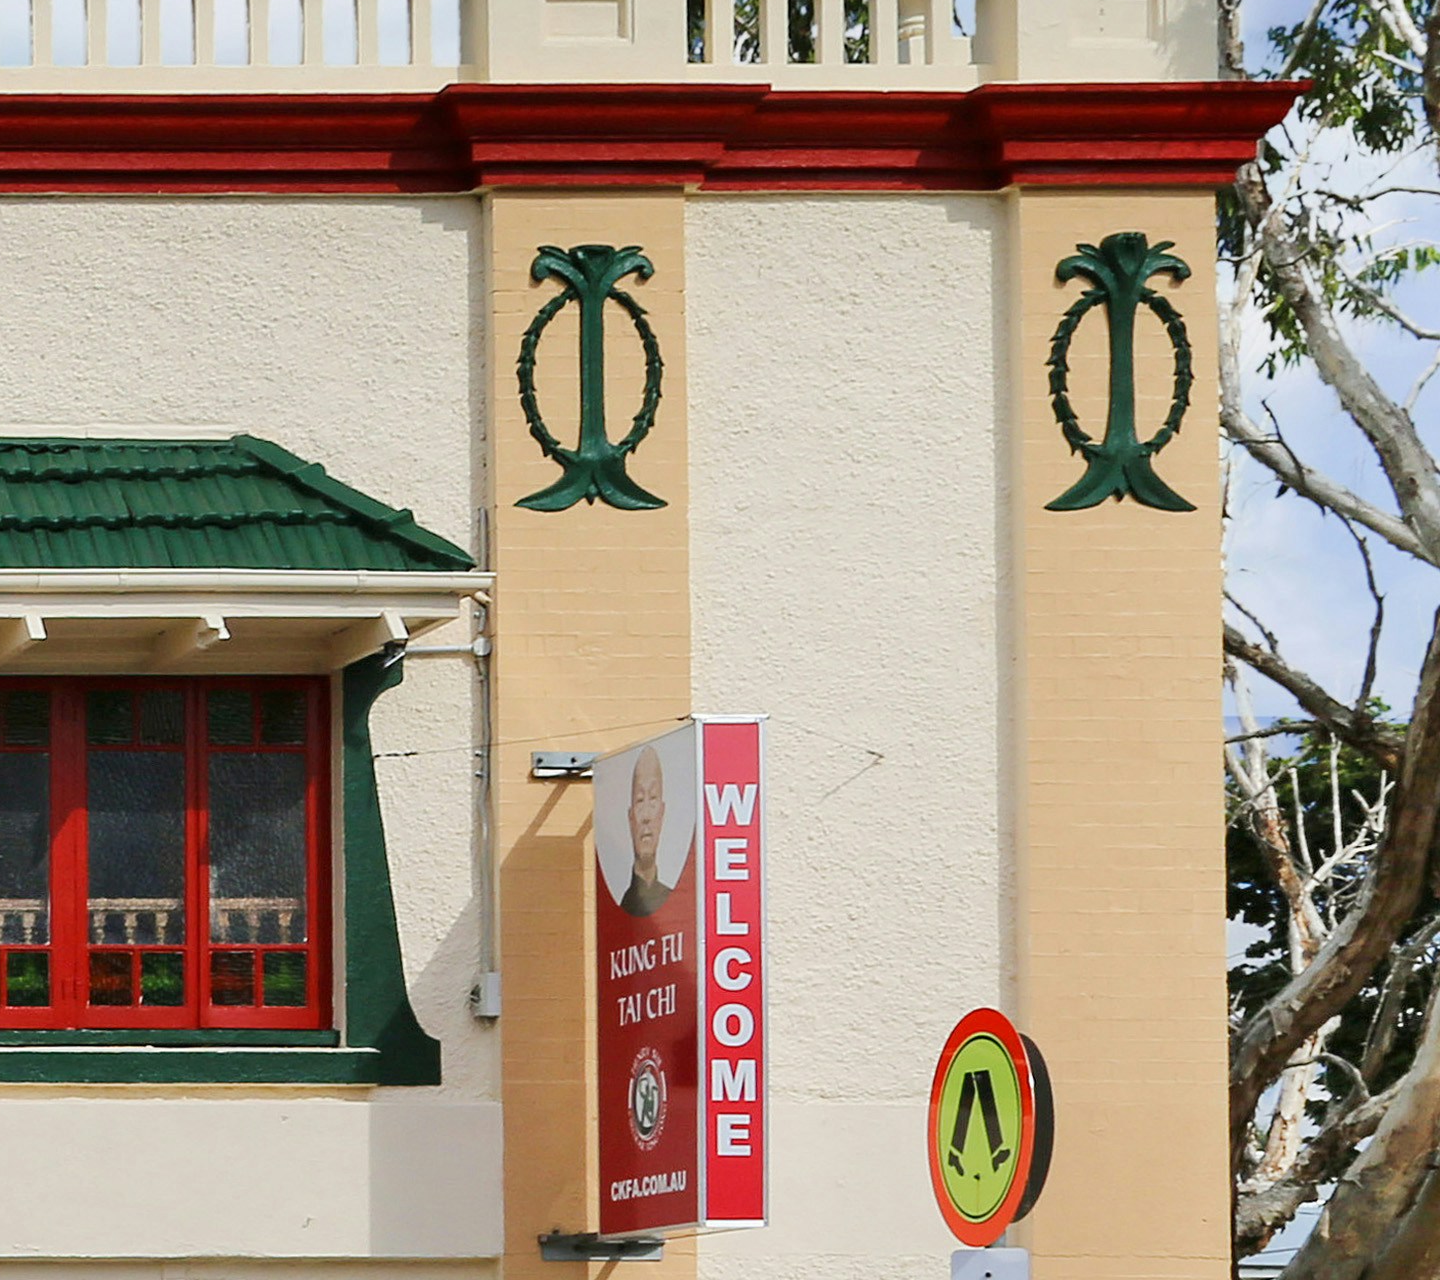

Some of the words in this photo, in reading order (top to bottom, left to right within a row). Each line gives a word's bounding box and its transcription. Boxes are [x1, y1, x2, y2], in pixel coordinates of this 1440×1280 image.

[609, 937, 657, 982] KUNG
[661, 931, 684, 965] FU
[704, 782, 758, 1157] WELCOME
[617, 995, 642, 1027] TAI
[646, 982, 676, 1022] CHI
[610, 1168, 687, 1203] CKFA.COM.AU
